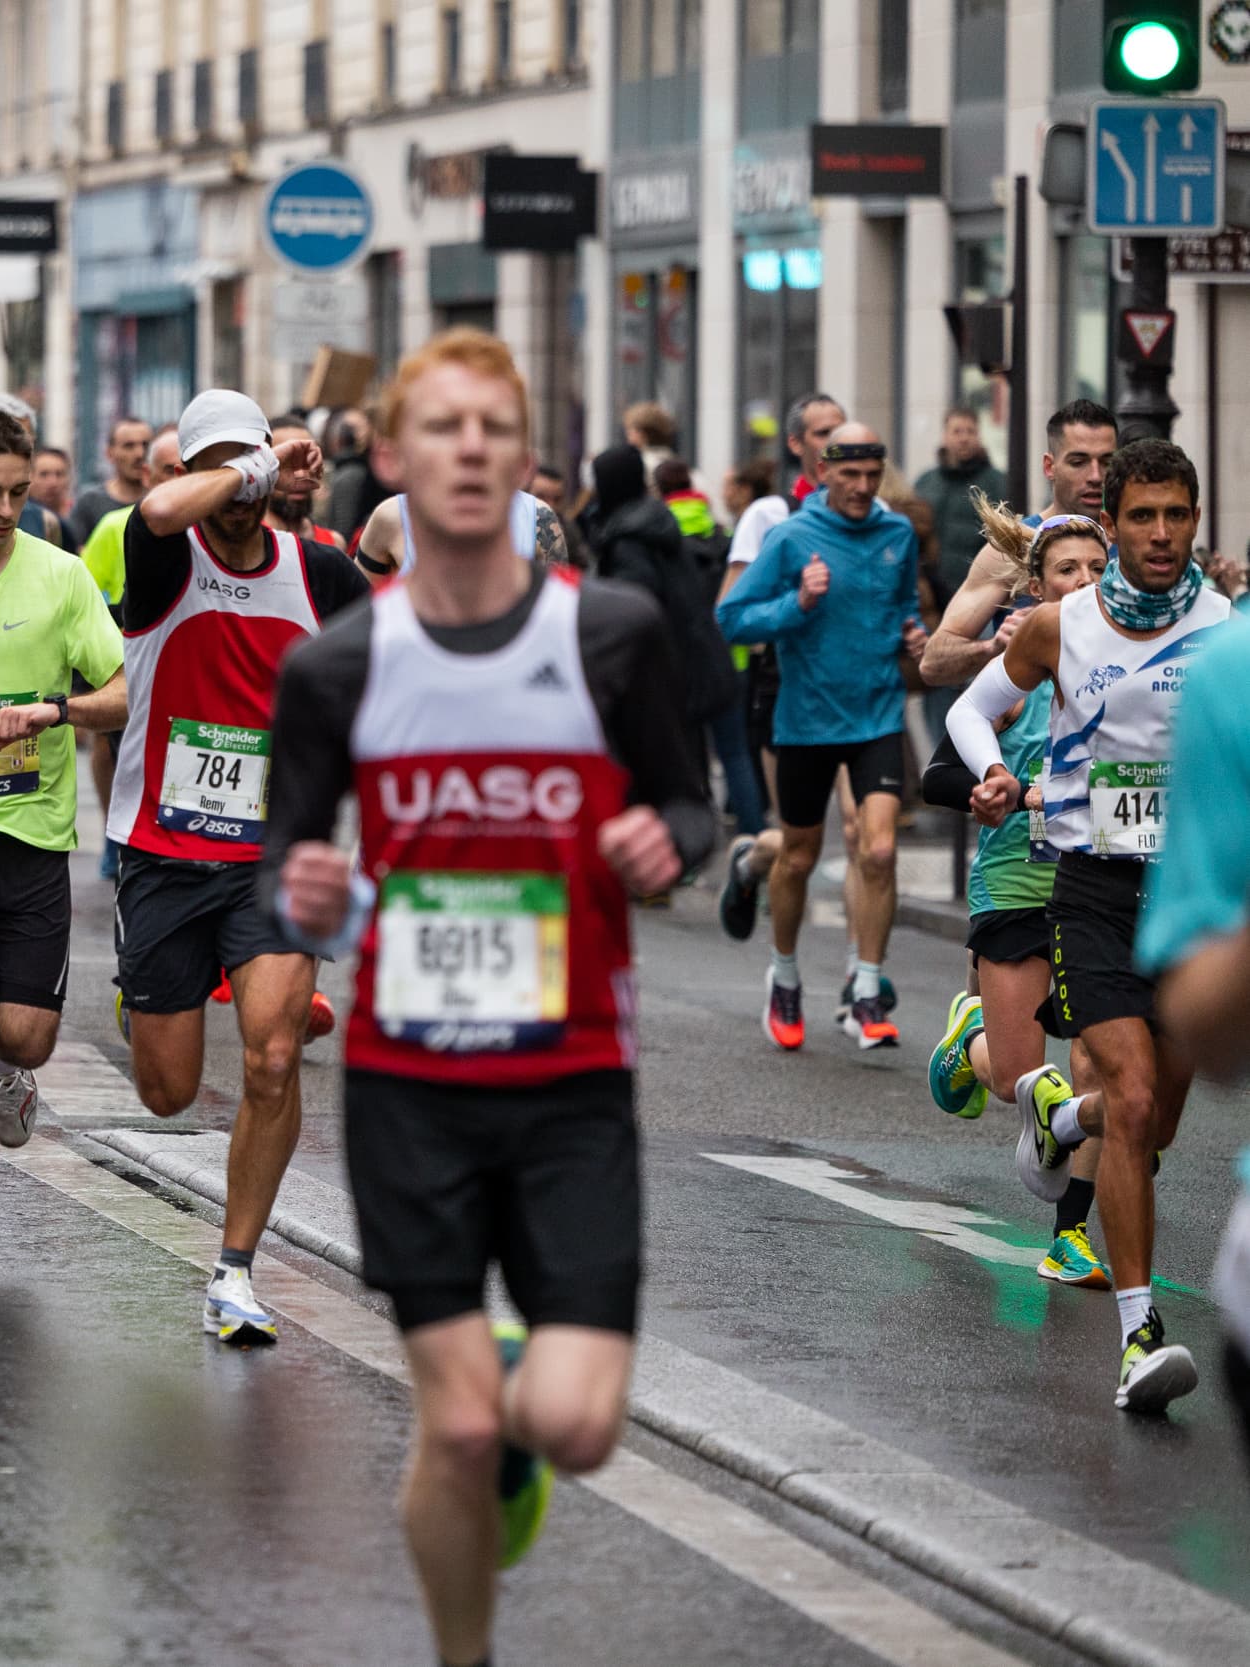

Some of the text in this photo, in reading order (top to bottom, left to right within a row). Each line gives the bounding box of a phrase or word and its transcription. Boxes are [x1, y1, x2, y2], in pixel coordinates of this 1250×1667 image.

[197, 577, 251, 600] UASG
[198, 725, 262, 745] Schneider
[224, 741, 261, 752] Electric
[195, 752, 242, 791] 784
[378, 765, 583, 823] UASG
[199, 795, 226, 815] Remy
[1113, 791, 1168, 827] 414
[205, 820, 244, 837] asics
[1138, 833, 1156, 849] FLO
